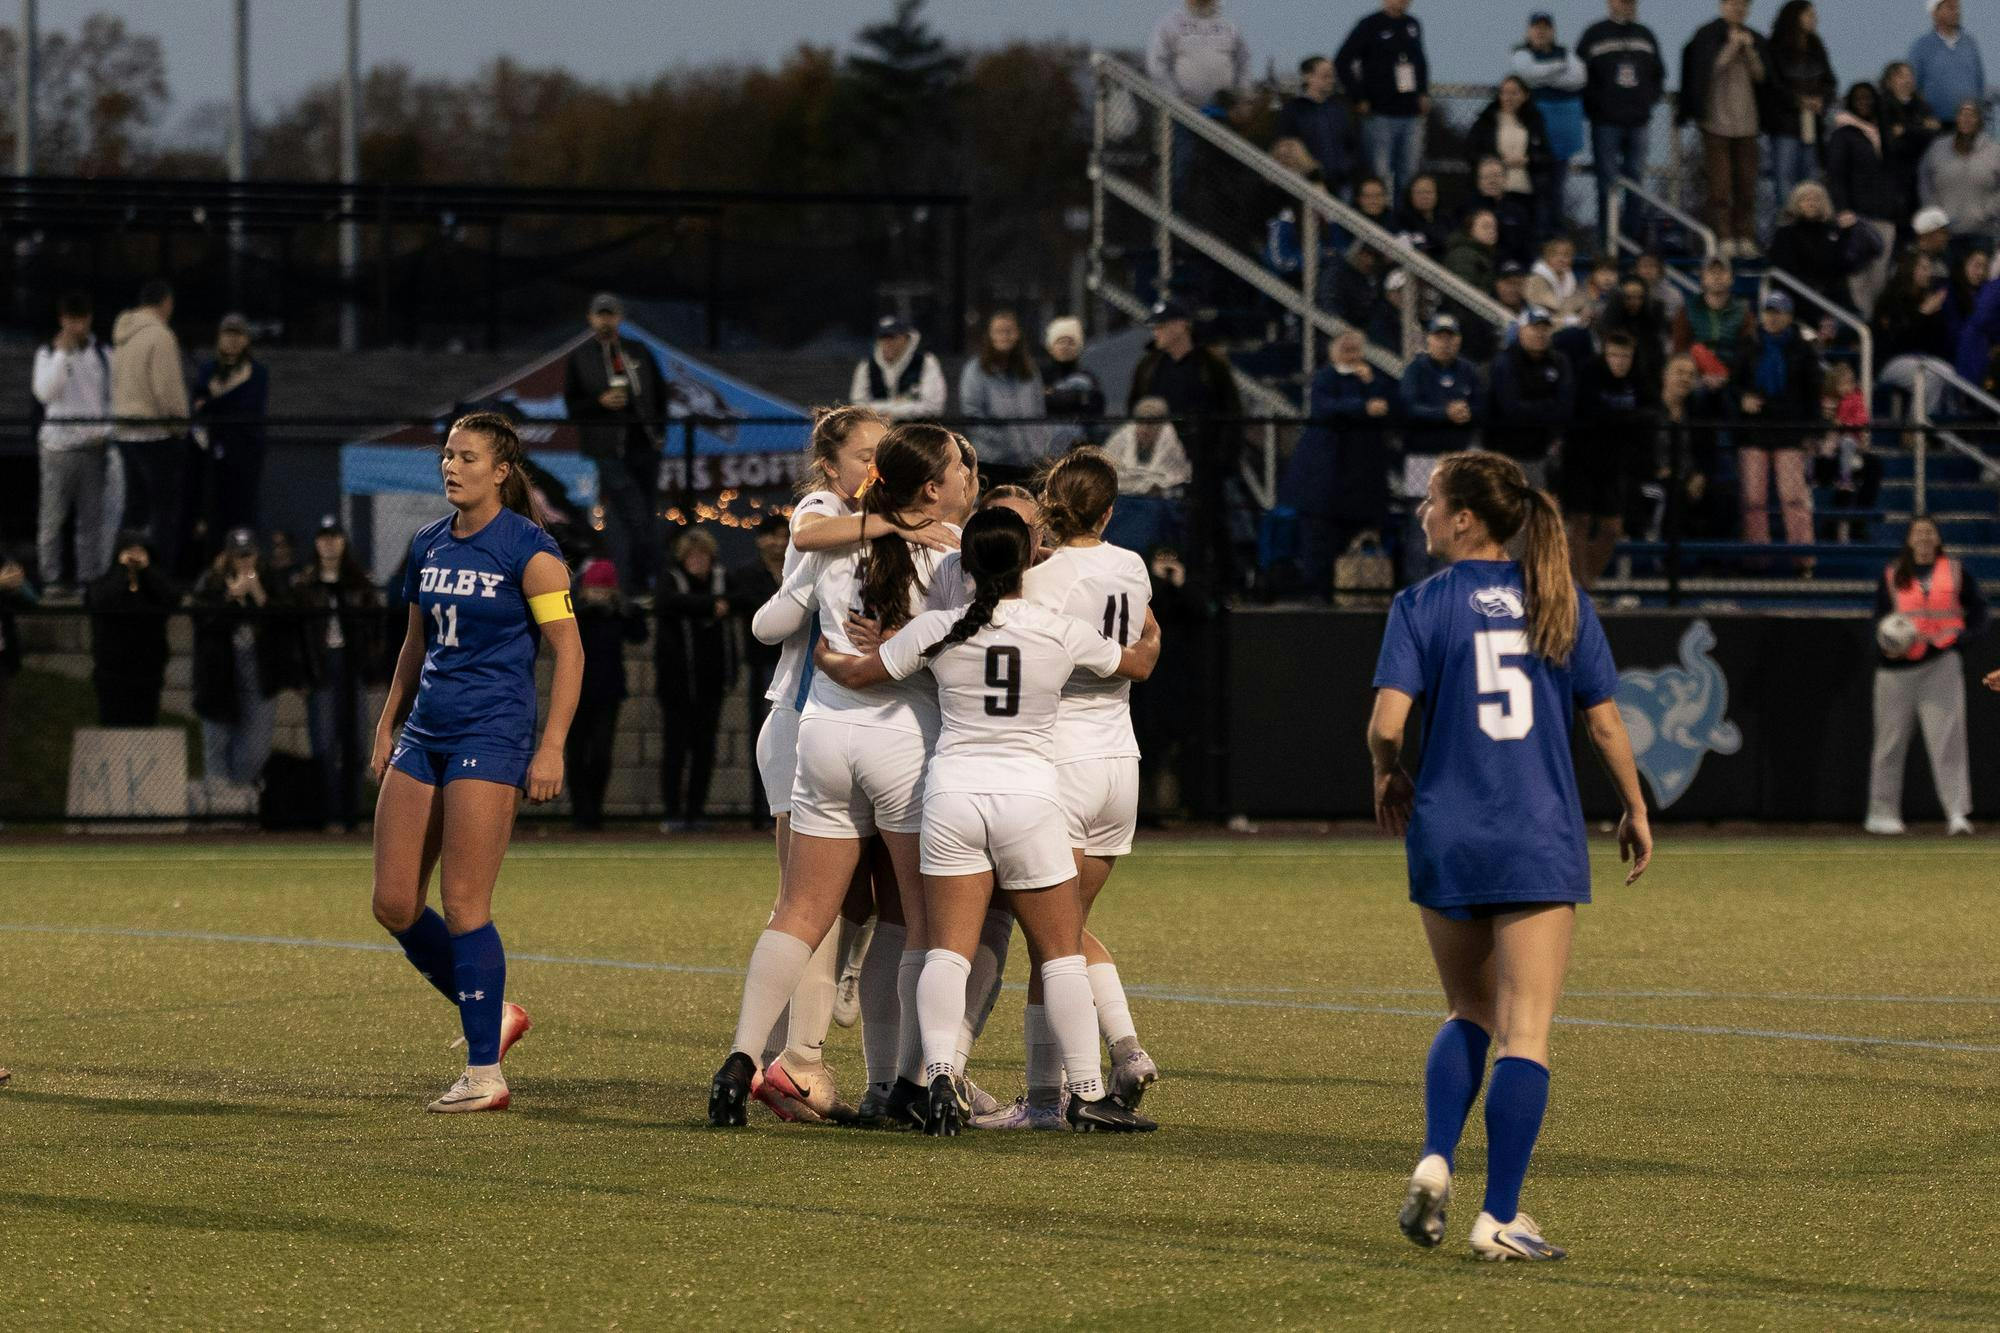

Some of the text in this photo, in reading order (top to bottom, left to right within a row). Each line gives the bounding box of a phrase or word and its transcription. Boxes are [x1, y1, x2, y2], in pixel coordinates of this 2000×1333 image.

[430, 602, 460, 648] 11
[1098, 591, 1130, 648] 11
[983, 644, 1022, 718] 9
[1473, 629, 1535, 742] 5
